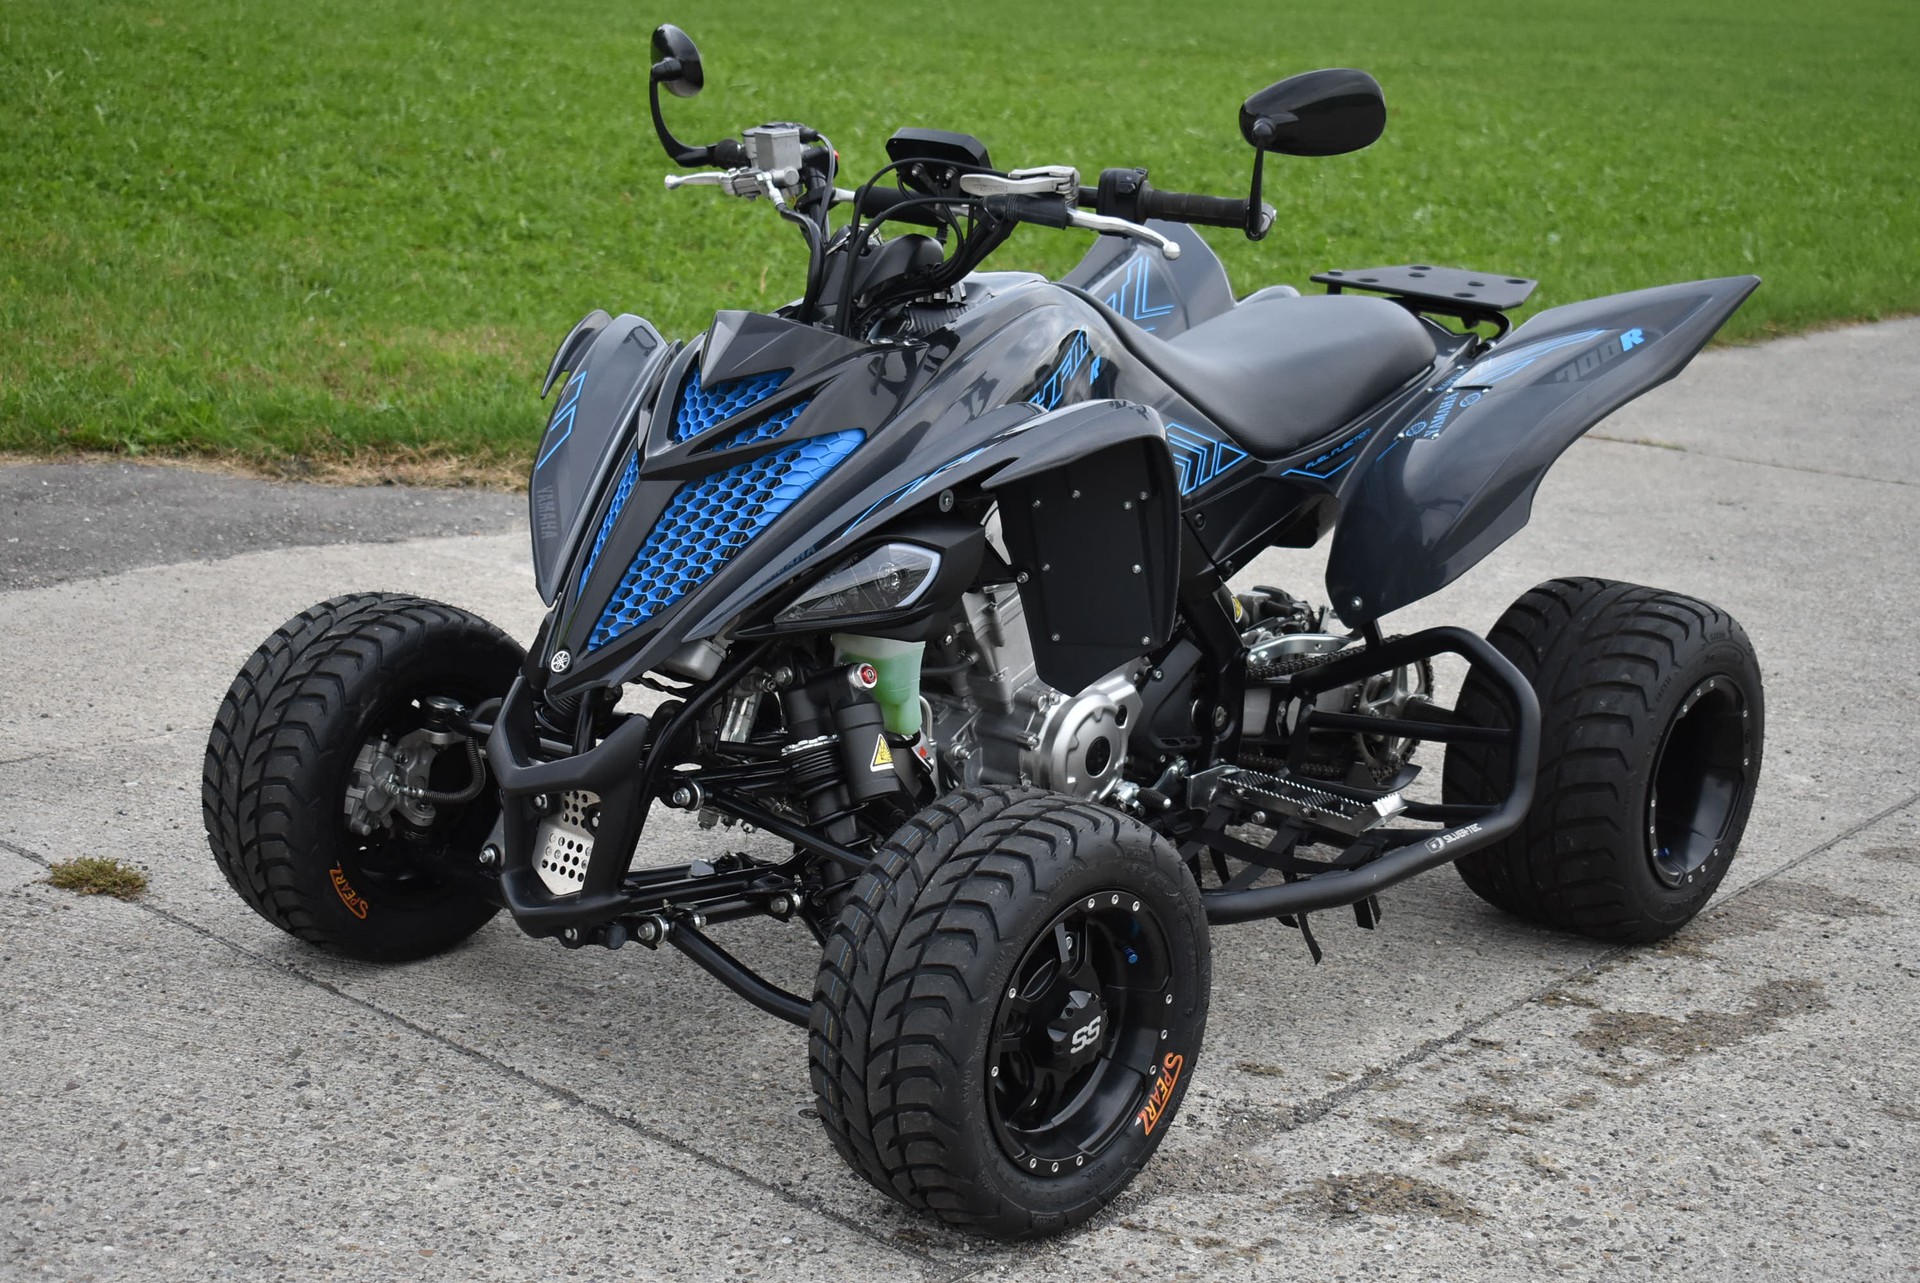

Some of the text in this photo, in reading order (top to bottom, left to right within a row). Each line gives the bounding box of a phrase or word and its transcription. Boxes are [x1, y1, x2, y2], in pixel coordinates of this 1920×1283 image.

[1423, 392, 1460, 438] YAMAHA
[1305, 454, 1331, 471] FUEL
[536, 484, 559, 540] YAMAHA
[328, 860, 369, 920] SPEARZ
[1070, 1015, 1101, 1054] SS
[1136, 1052, 1183, 1136] SPEARZ
